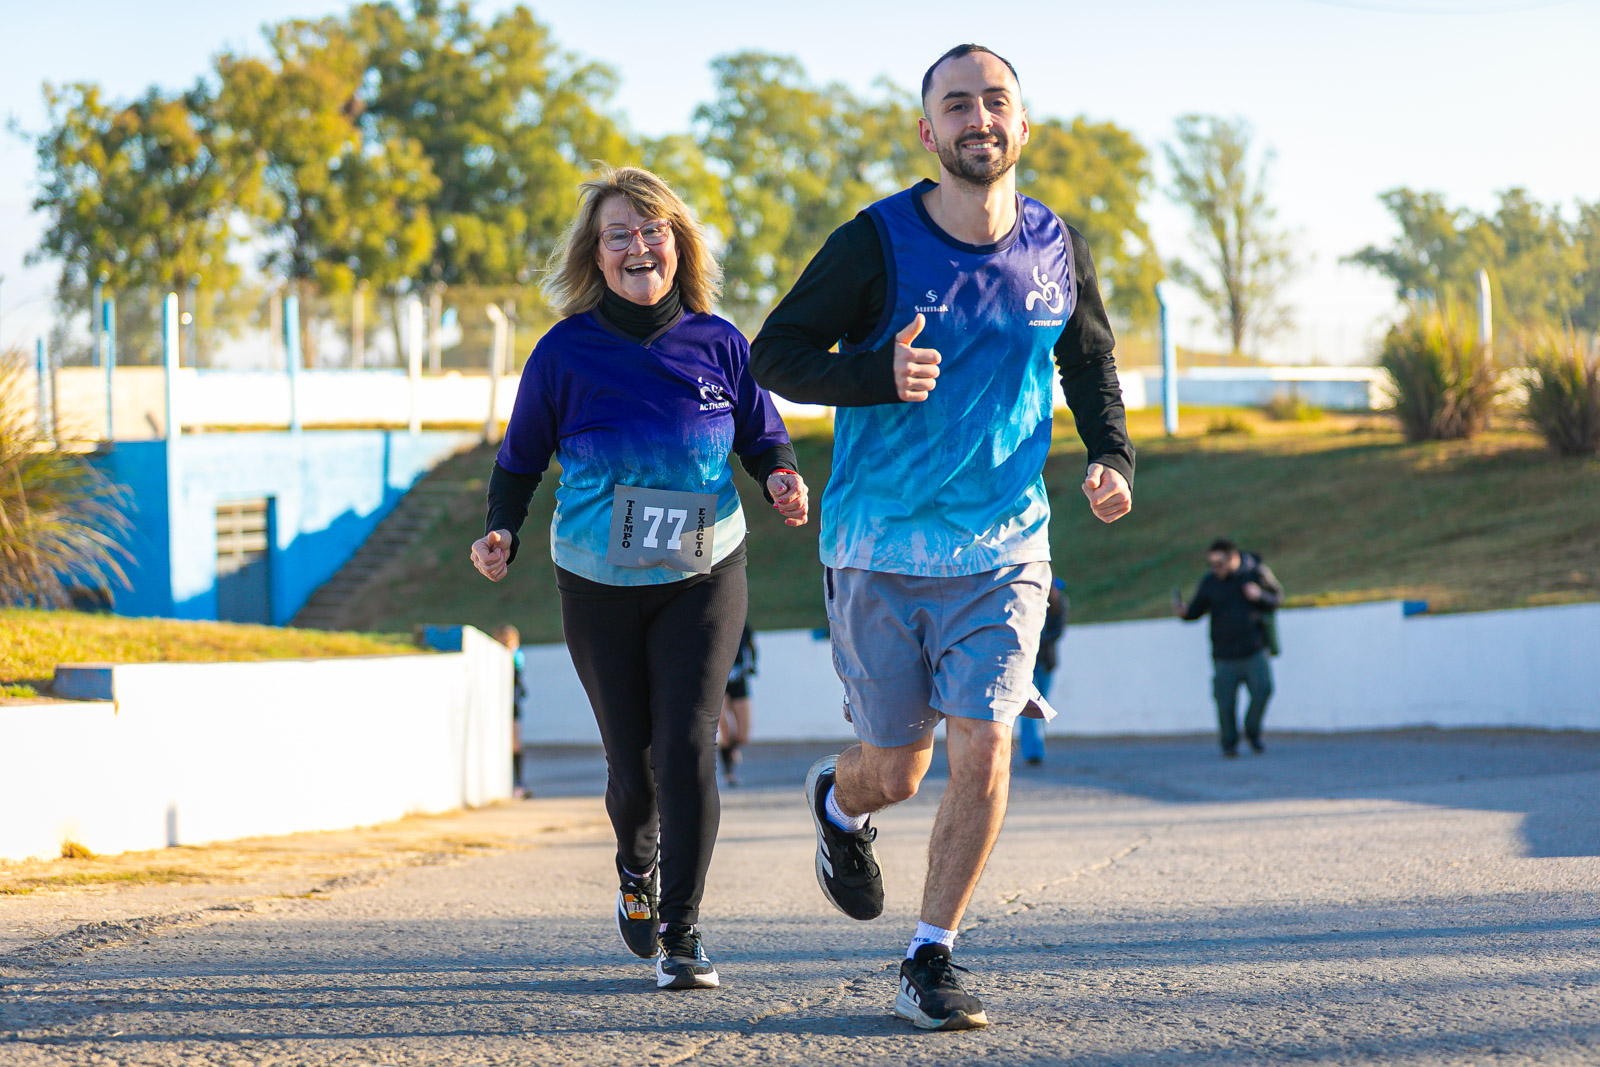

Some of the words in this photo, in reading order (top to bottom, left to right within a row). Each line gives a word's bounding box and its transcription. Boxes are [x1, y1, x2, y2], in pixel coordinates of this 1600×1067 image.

[1028, 319, 1051, 327] ACTIVE
[621, 499, 636, 549] TIEMPO
[642, 506, 688, 550] 77
[694, 507, 706, 558] EXACTO
